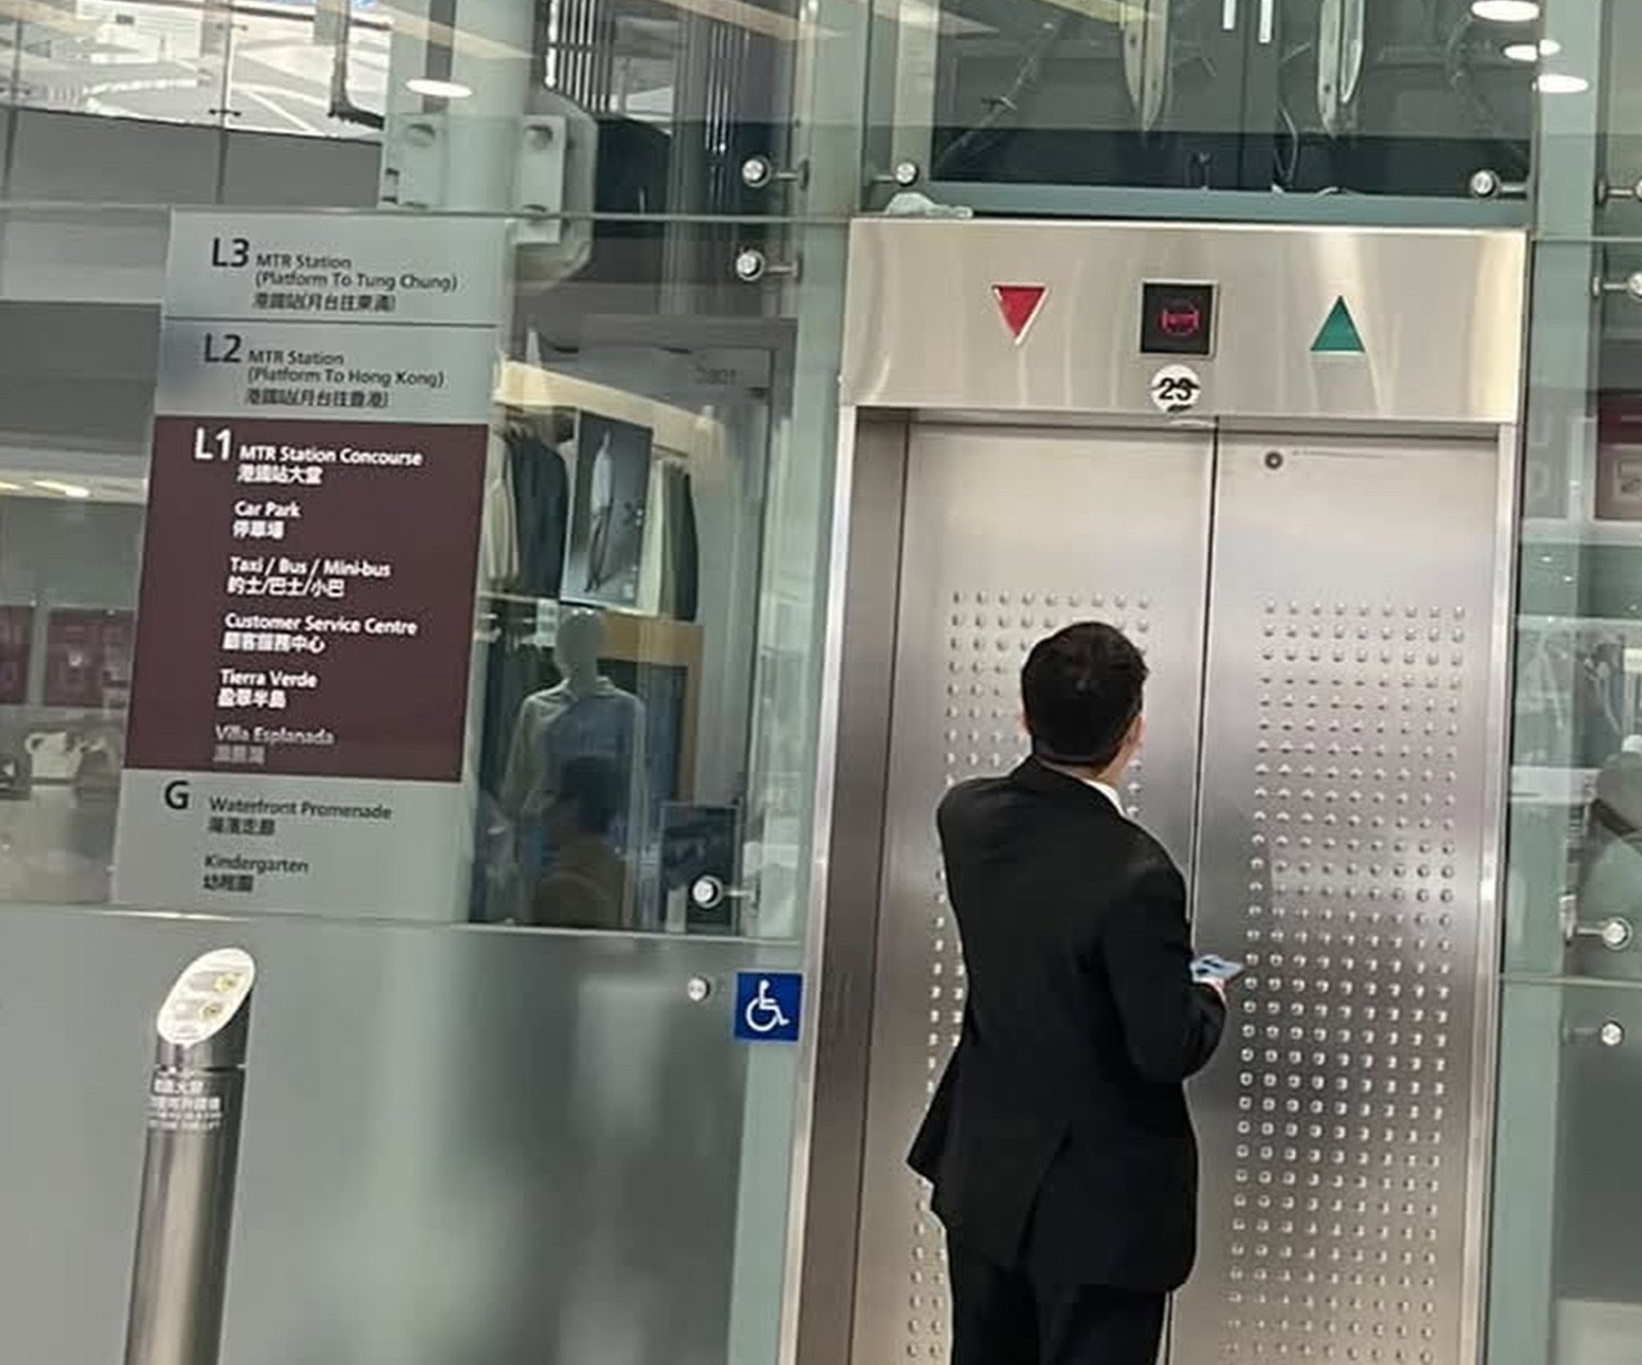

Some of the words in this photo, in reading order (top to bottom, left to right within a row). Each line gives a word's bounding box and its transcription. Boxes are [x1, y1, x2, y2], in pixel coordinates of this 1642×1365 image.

[211, 238, 250, 267] L3
[255, 254, 292, 268] MTR
[295, 254, 352, 269] Station
[254, 270, 329, 288] (Platform
[332, 272, 353, 287] To
[356, 273, 397, 291] Tung
[399, 274, 458, 292] Chung)
[203, 333, 242, 363] L2
[247, 350, 284, 363] MTR
[287, 350, 345, 365] Station
[247, 366, 321, 384] (Platform
[324, 369, 345, 383] To
[347, 370, 392, 388] Hong
[395, 371, 445, 388] Kong)
[194, 428, 231, 460] L1
[239, 445, 277, 460] MTR
[279, 446, 337, 462] Station
[339, 448, 423, 465] Concourse
[234, 501, 263, 516] Car
[264, 502, 301, 517] Park
[230, 557, 264, 572] Taxi
[278, 558, 308, 574] Bus
[323, 560, 391, 577] Mini-bus
[224, 613, 302, 630] Customer
[304, 615, 362, 632] Service
[364, 618, 418, 635] Centre
[220, 669, 266, 685] Tierra
[269, 671, 318, 687] Verde
[215, 725, 250, 740] Villa
[164, 780, 190, 810] G
[208, 797, 297, 814] Waterfront
[300, 801, 393, 819] Promenade
[203, 854, 309, 874] Kindergarten
